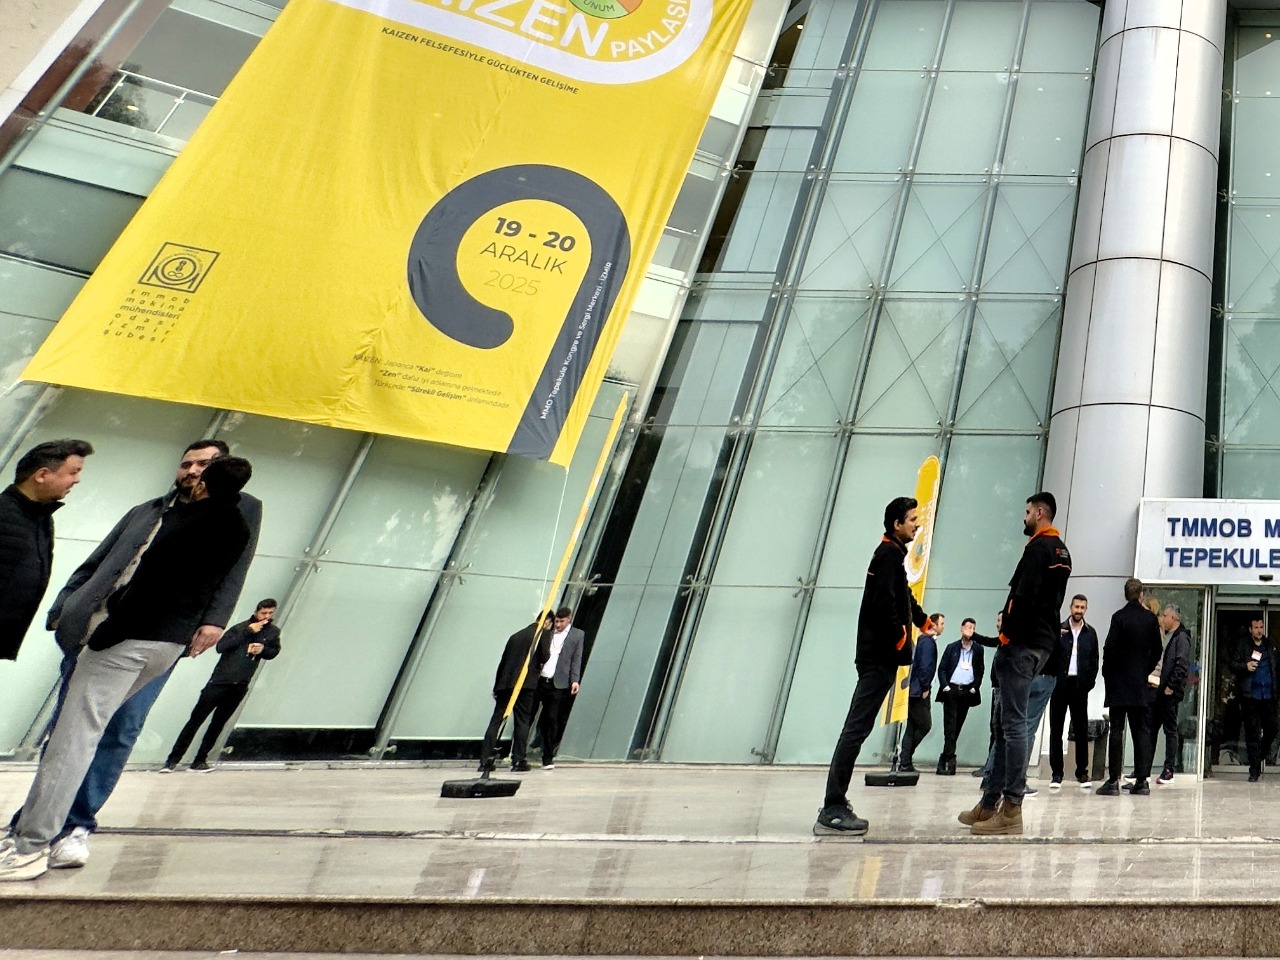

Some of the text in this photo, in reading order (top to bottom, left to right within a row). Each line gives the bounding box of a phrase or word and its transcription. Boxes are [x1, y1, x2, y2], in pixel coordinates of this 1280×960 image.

[381, 26, 580, 95] KAIZEN FELSEFESİYLE GÜÇLÜKTEN GELİŞİME
[494, 216, 522, 237] 19
[542, 231, 576, 252] 20
[479, 241, 568, 275] ARALIK
[484, 269, 542, 296] 2025
[119, 304, 180, 320] mühendisleri
[540, 399, 554, 420] MMO
[563, 339, 580, 366] Kongre
[1167, 517, 1253, 538] TMMOB
